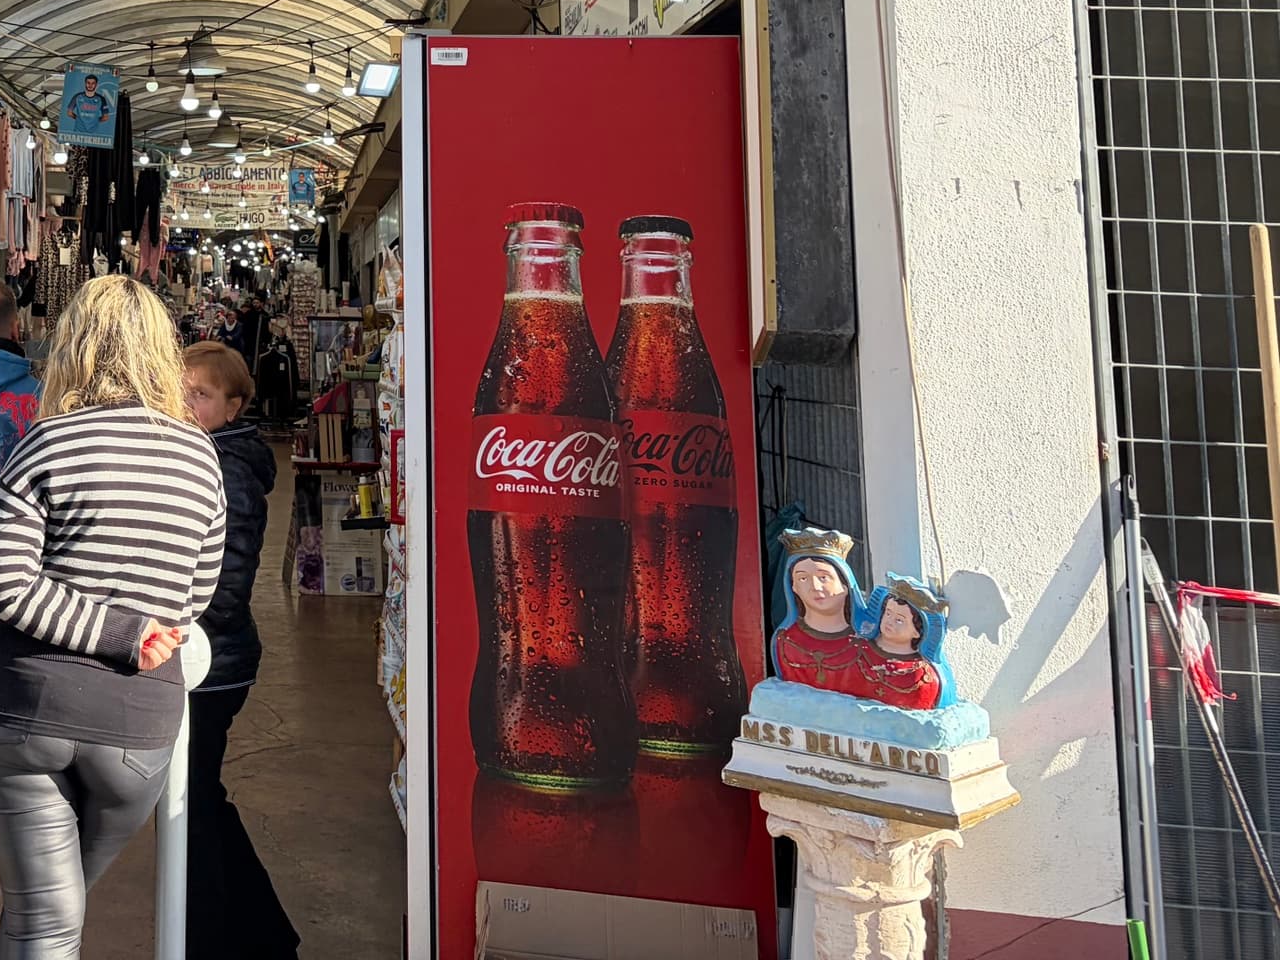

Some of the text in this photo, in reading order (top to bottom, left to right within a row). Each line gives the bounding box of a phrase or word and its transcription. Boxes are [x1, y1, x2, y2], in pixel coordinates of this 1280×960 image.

[475, 425, 620, 488] Coca-Cola
[495, 483, 601, 498] ORIGINAL TASTE
[634, 477, 714, 490] ZERO SUGAR
